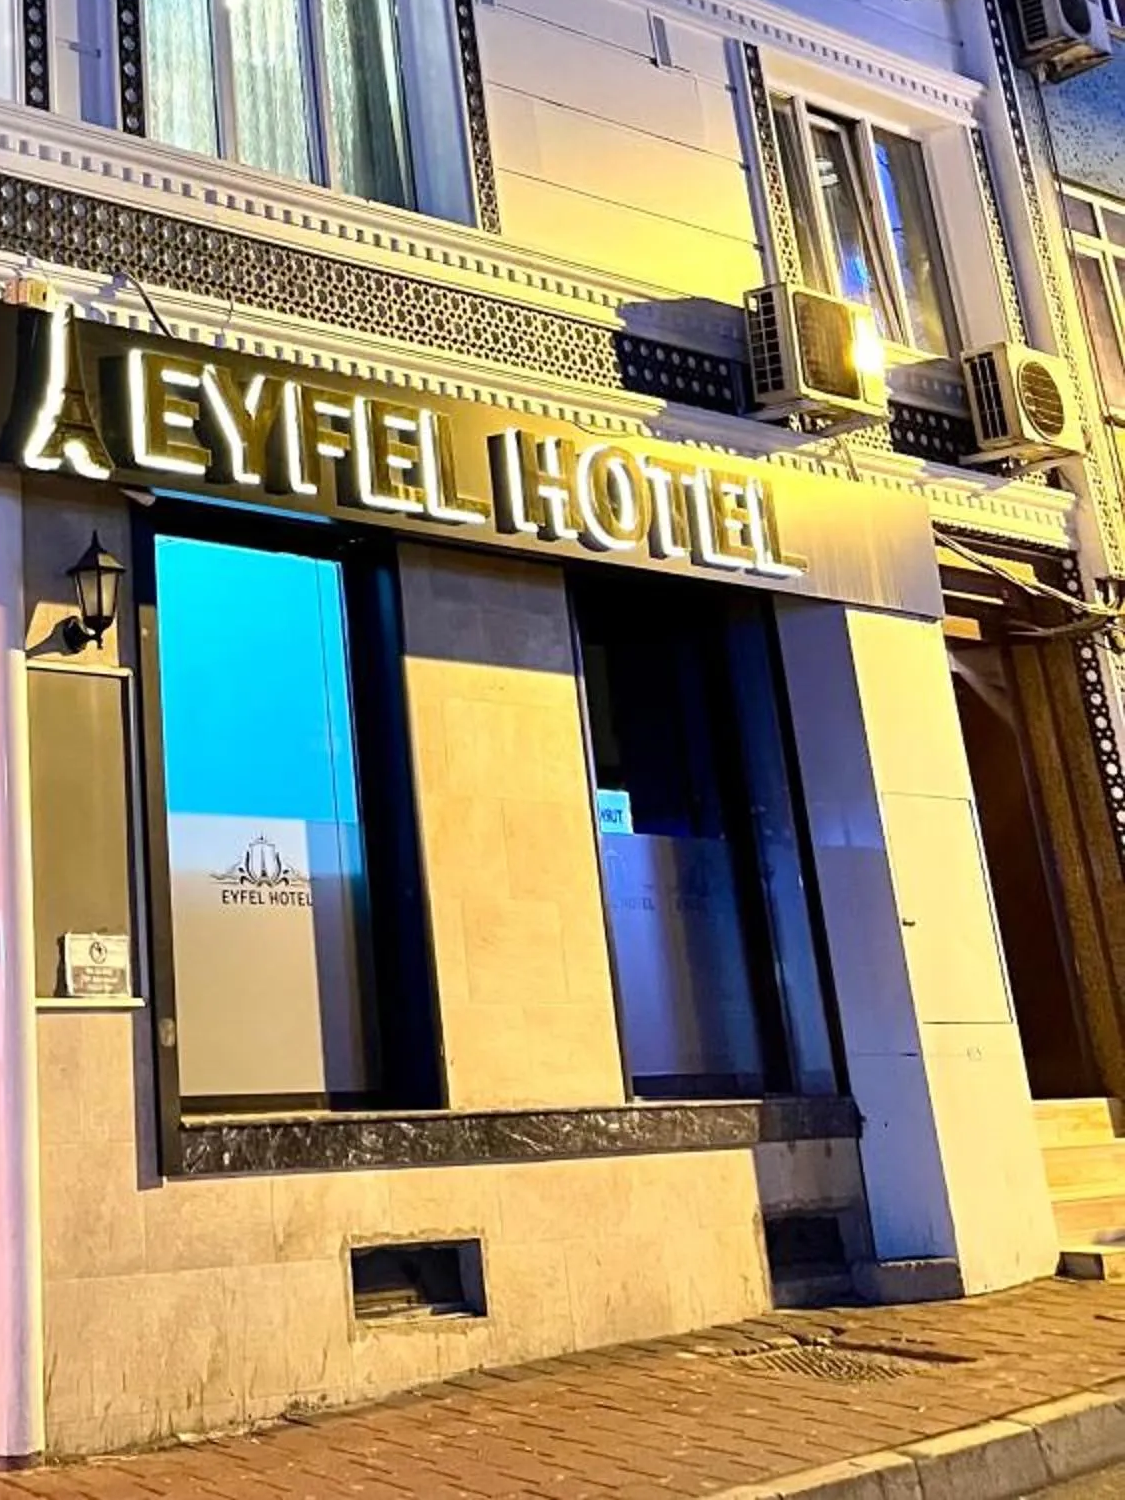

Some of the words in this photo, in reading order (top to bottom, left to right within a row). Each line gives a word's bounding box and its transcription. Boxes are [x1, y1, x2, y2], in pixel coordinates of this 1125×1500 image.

[127, 347, 491, 526] EYFEL
[488, 426, 811, 579] HOTEL
[221, 889, 265, 905] EYFEL
[269, 891, 314, 907] HOTEL
